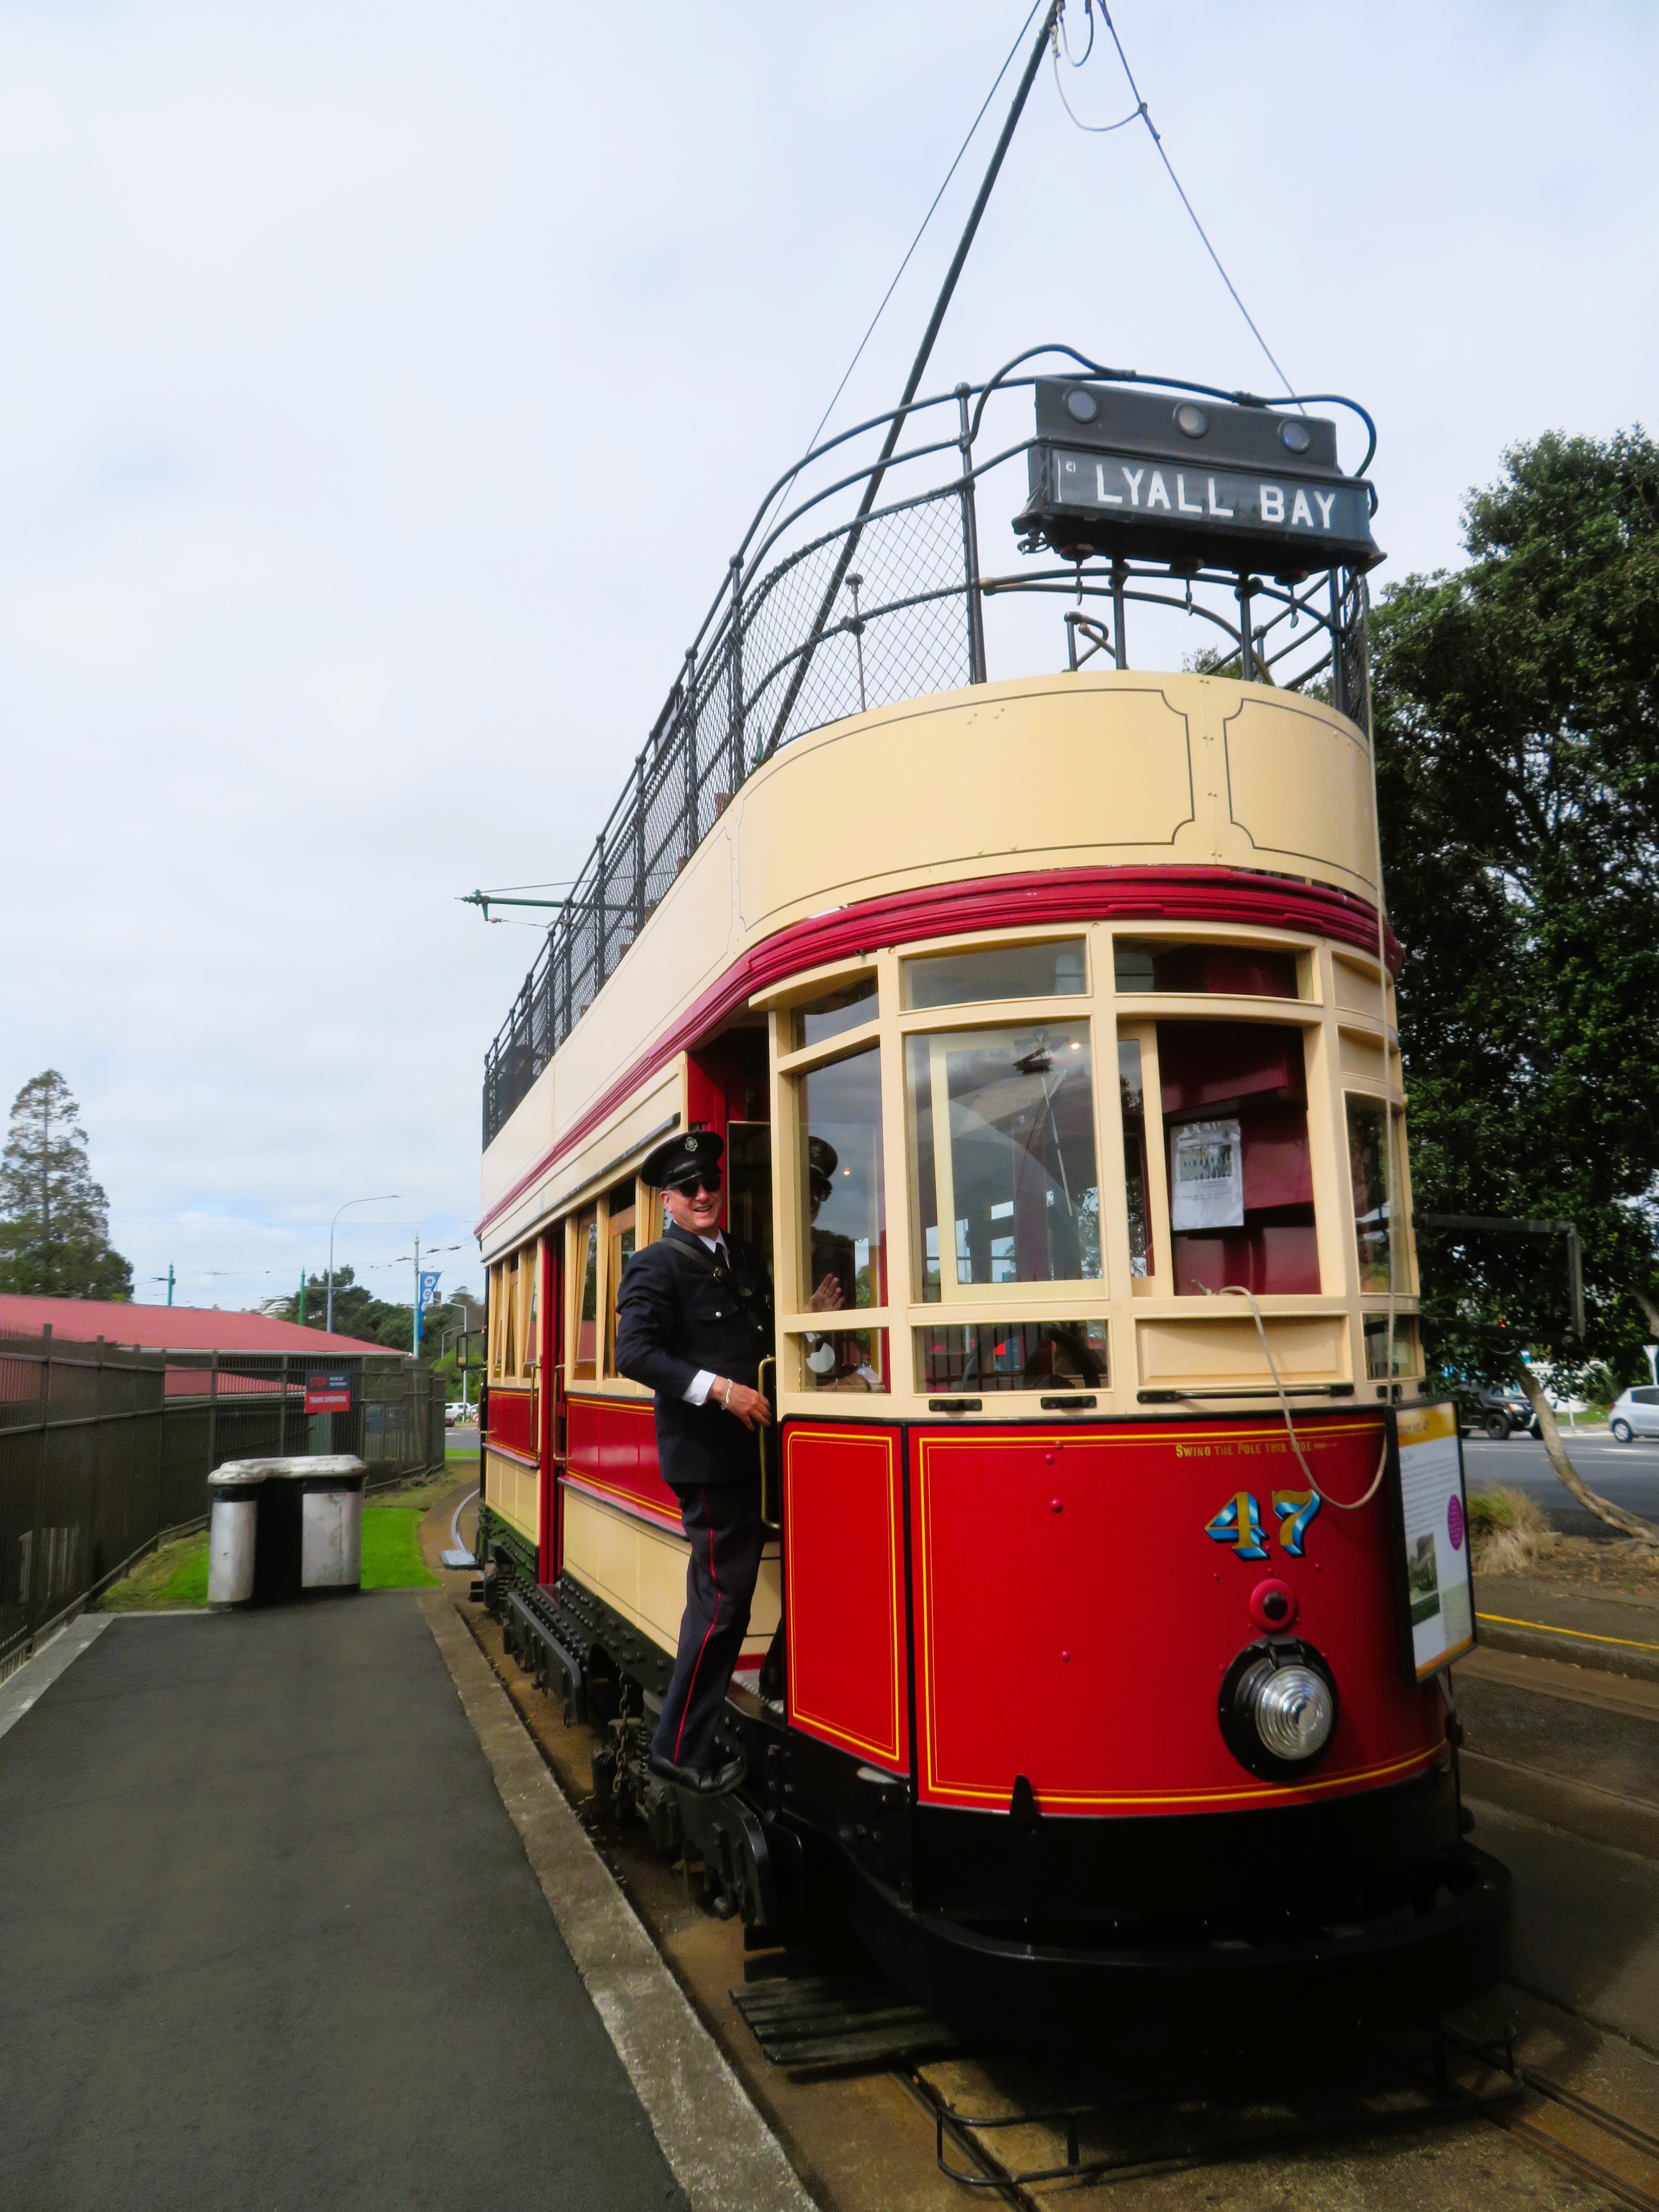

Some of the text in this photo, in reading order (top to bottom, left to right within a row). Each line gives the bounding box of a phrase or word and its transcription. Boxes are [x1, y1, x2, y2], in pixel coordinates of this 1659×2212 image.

[1096, 463, 1336, 529] LYALL BAY
[1205, 1489, 1321, 1561] 47
